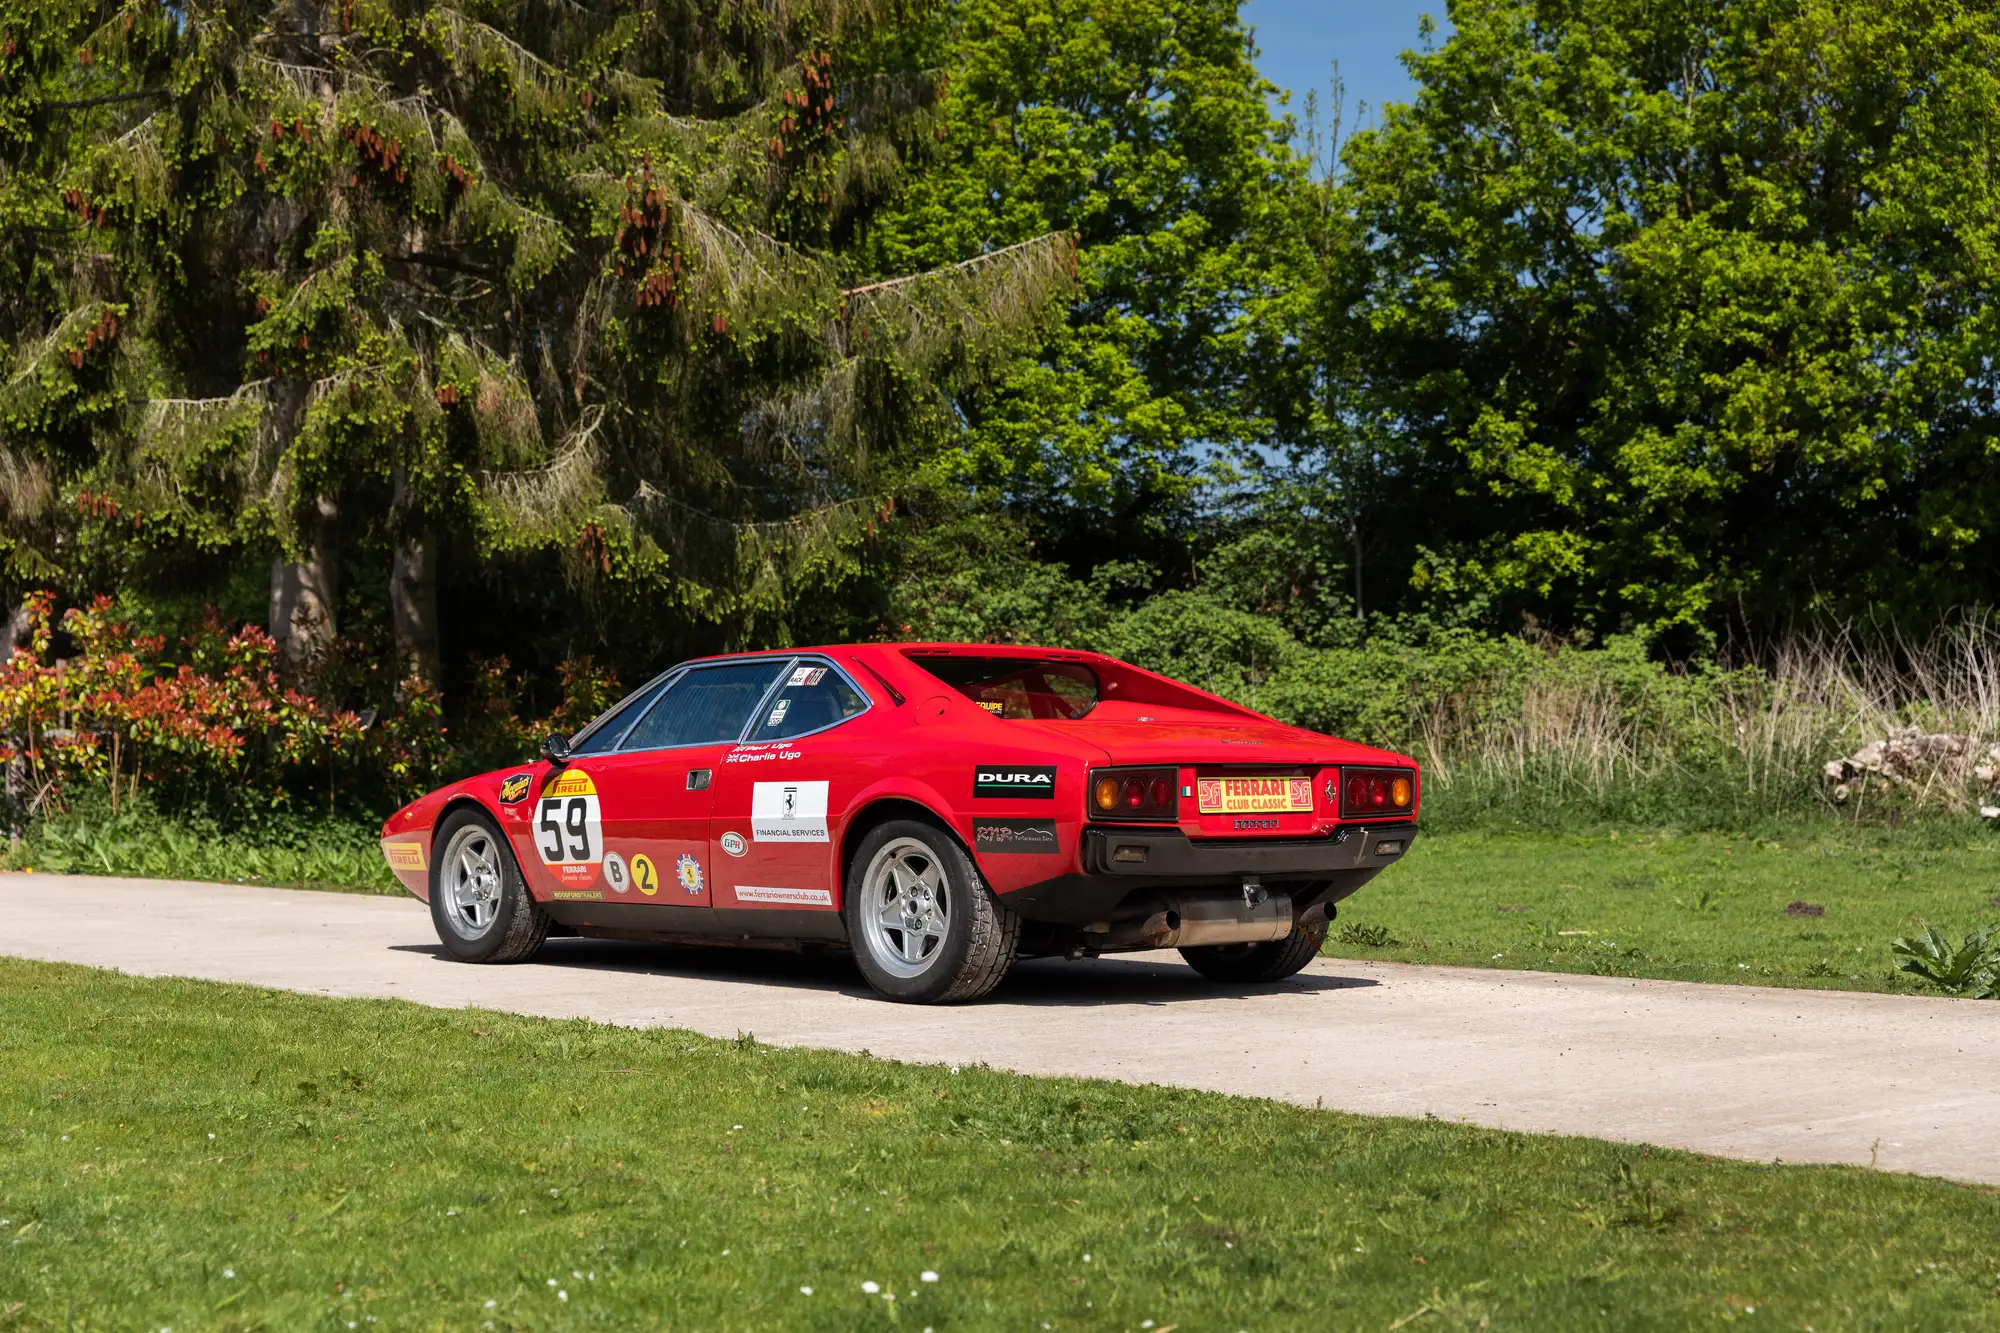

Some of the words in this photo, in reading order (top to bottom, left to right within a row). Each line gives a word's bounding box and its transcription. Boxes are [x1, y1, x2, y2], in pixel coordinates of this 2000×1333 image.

[745, 744, 770, 752] Paul
[771, 742, 793, 750] Ugo
[739, 752, 776, 763] Charlie
[779, 751, 802, 760] Ugo
[977, 773, 1051, 783] DURA
[552, 778, 589, 794] PIRELLI
[1225, 778, 1286, 797] FERRARI
[1226, 798, 1250, 810] CLUB
[1251, 798, 1287, 810] CLASSIC
[541, 797, 591, 862] 59
[756, 829, 790, 837] FINANCIAL
[791, 829, 825, 837] SERVICES
[724, 838, 741, 850] GPR
[389, 848, 421, 865] PIRELLI
[562, 865, 587, 874] FERRARI
[609, 860, 623, 883] B
[636, 858, 655, 890] 2
[739, 889, 829, 902] www.ferrariownersclub.co.uk
